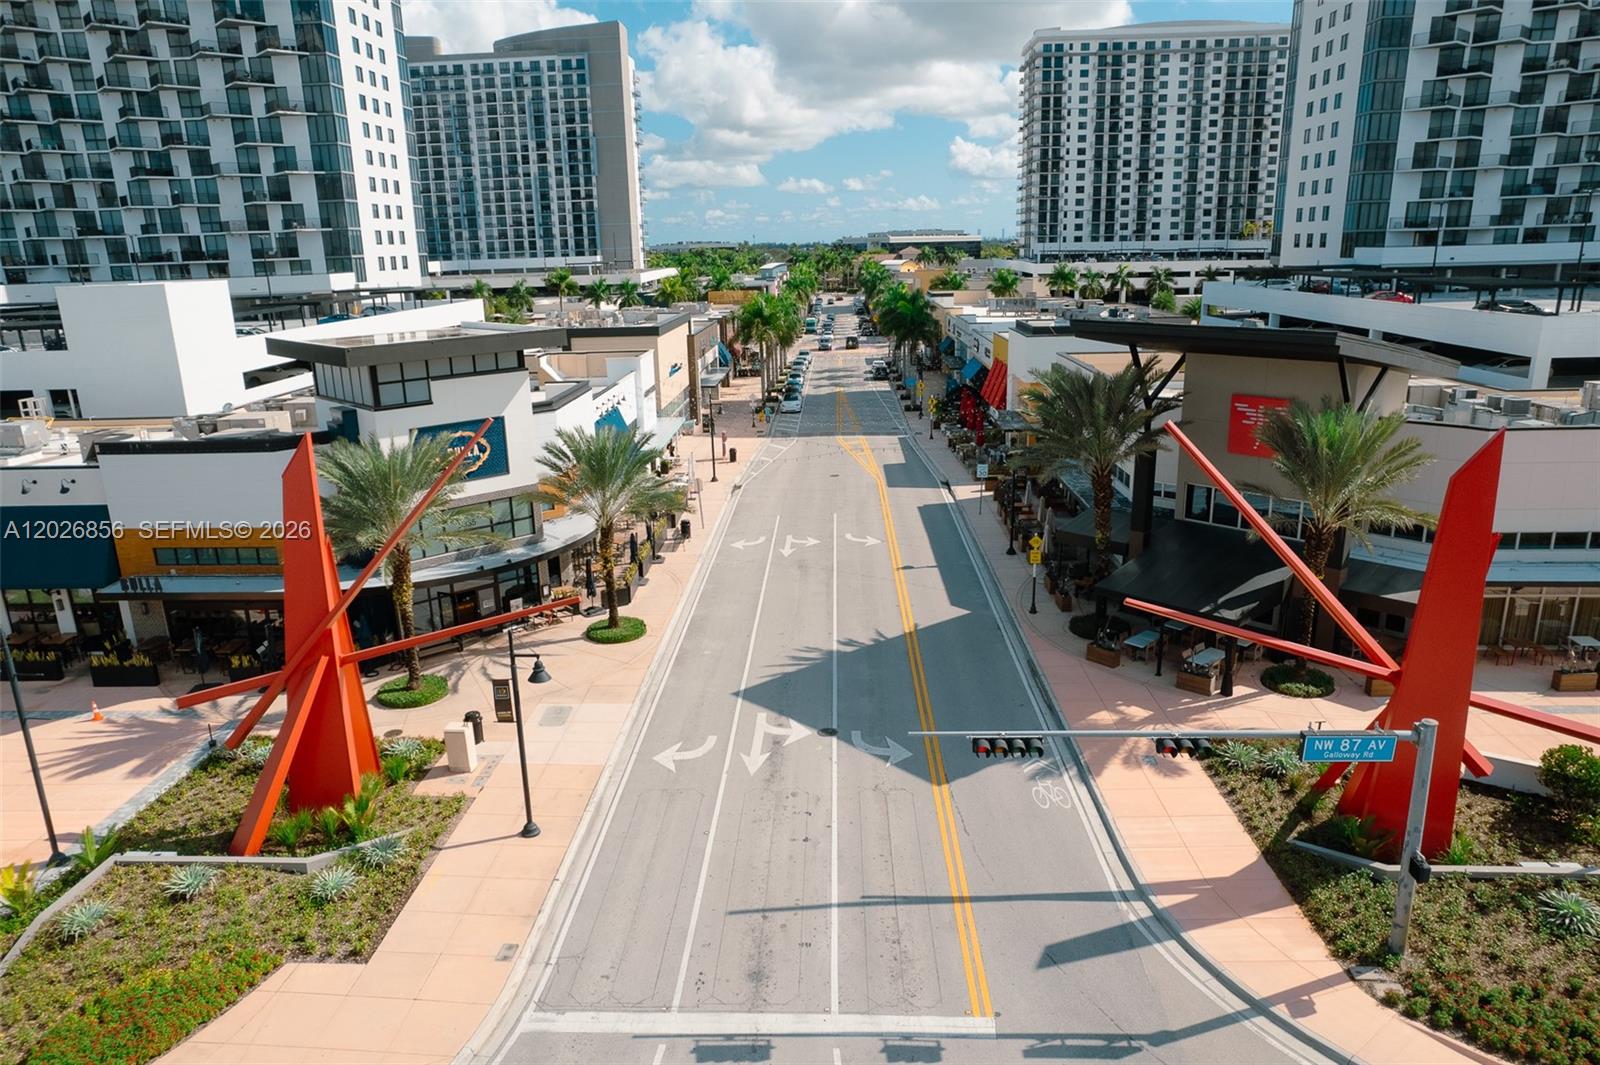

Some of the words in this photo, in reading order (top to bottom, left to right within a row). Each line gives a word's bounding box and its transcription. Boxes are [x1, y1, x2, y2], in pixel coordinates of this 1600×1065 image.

[1314, 741, 1333, 751] NW
[1340, 738, 1362, 752] 87
[1367, 740, 1386, 750] AV
[1323, 751, 1361, 760] Galloway
[1363, 751, 1374, 759] Rd
